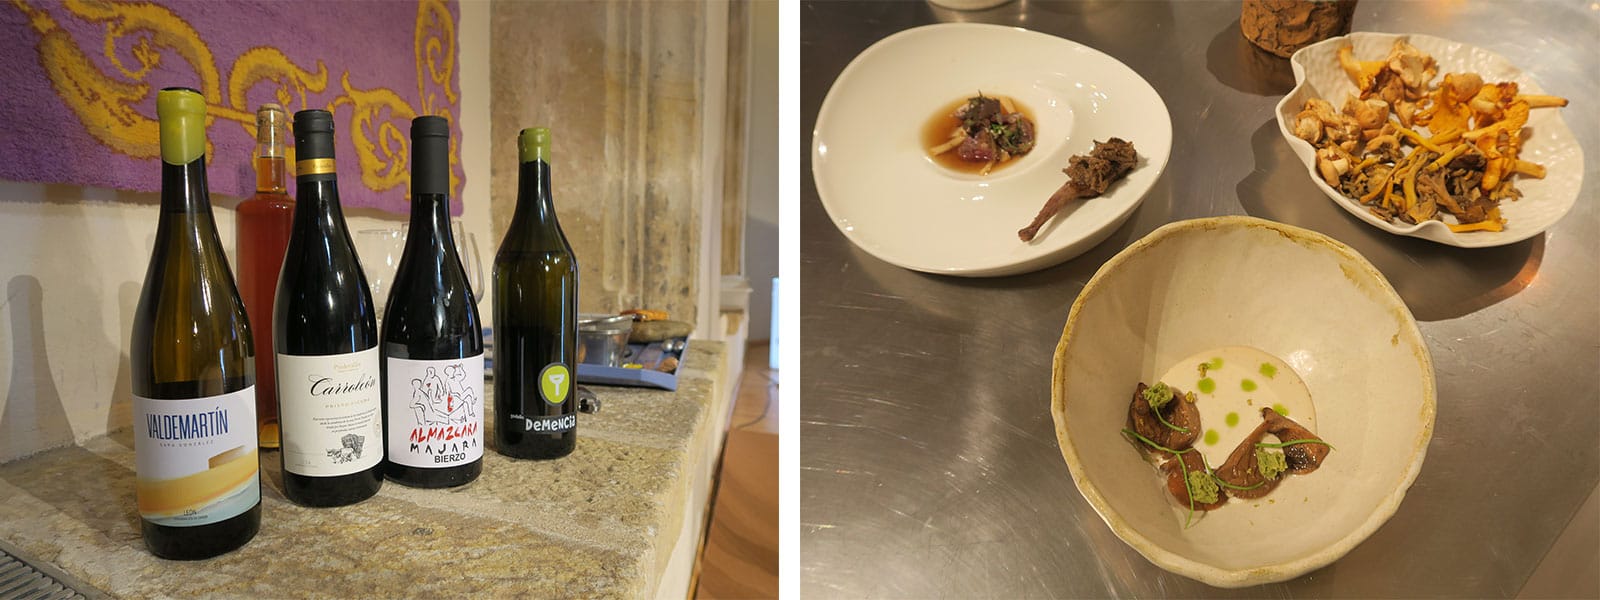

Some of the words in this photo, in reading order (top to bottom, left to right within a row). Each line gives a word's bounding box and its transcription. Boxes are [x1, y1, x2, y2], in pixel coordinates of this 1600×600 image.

[308, 373, 376, 396] Carroleón
[146, 406, 228, 440] VALDEMARTÍN
[410, 422, 477, 443] ALMAZCARA
[410, 438, 477, 455] MAJARA
[434, 452, 466, 463] BIERZO
